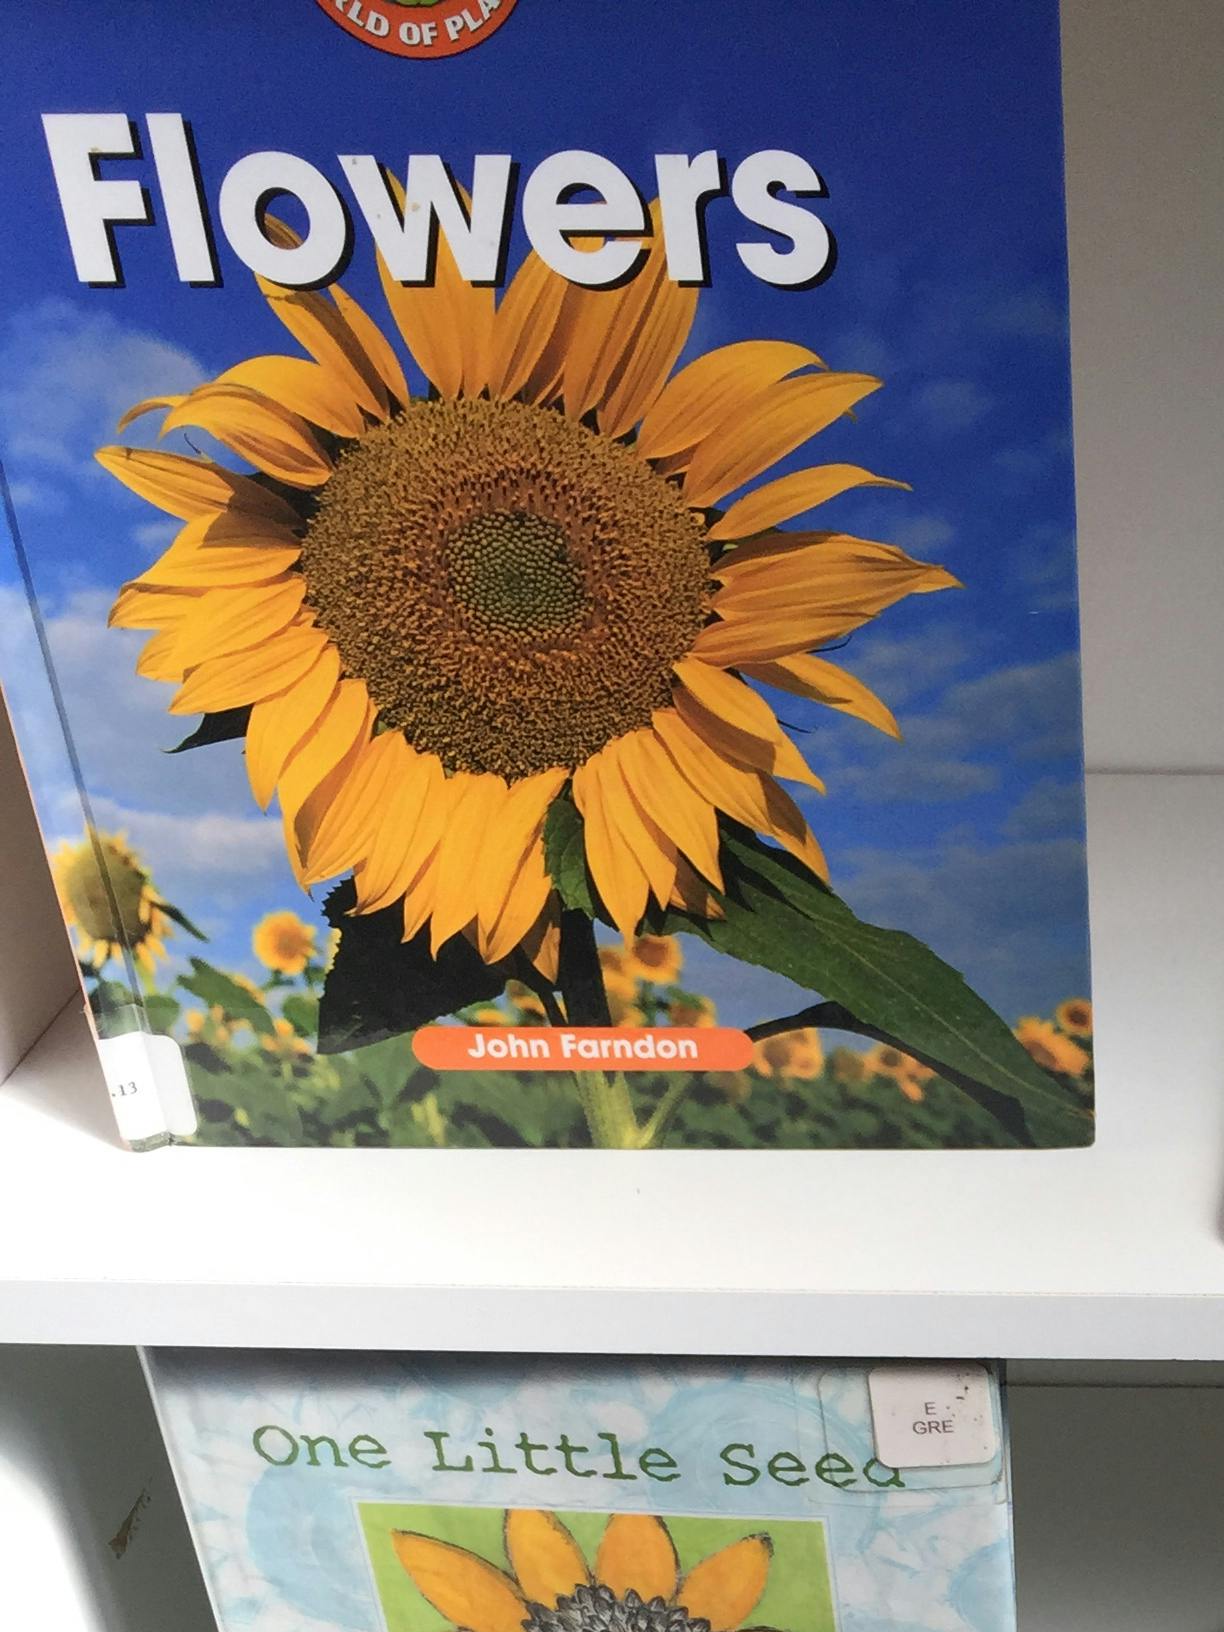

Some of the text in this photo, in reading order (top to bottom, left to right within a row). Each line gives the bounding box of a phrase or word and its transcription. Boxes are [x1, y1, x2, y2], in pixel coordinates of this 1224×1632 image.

[399, 22, 438, 46] OF
[41, 112, 834, 287] Flowers
[468, 1033, 699, 1060] John Farndon
[924, 1401, 937, 1415] E
[912, 1419, 955, 1435] GRE
[252, 1425, 391, 1470] One
[423, 1427, 681, 1482] Little
